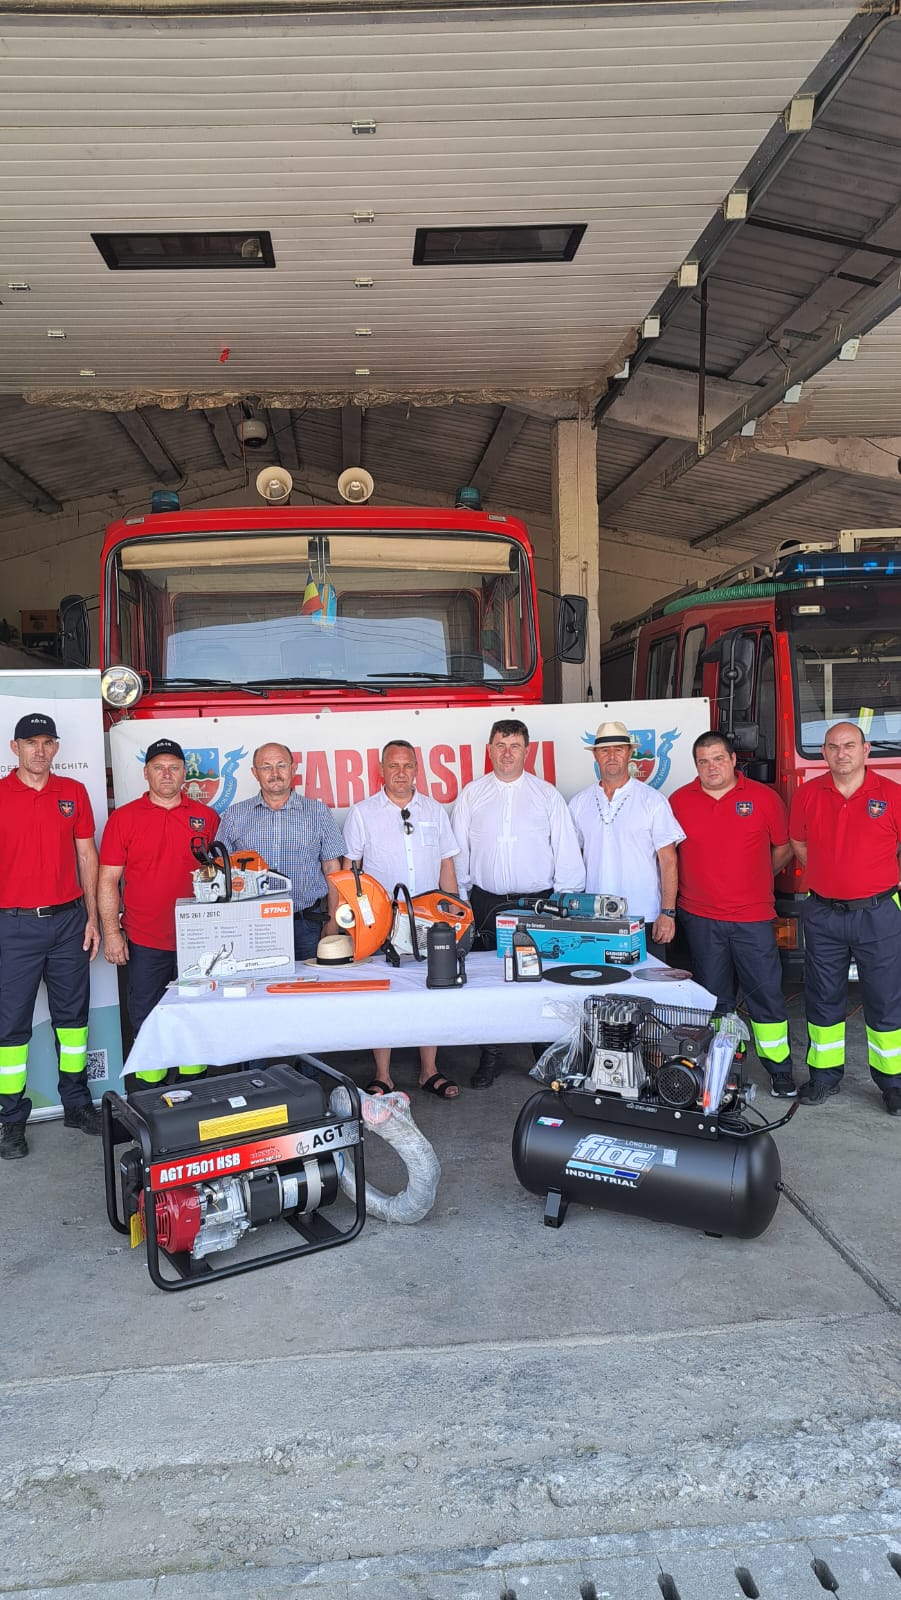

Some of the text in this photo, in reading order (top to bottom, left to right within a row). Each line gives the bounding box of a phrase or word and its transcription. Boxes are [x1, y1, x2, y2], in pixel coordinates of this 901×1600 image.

[49, 762, 89, 770] ARGHITA
[263, 906, 288, 914] STIHL
[312, 1124, 345, 1148] AGT
[625, 1139, 643, 1148] LONG
[574, 1135, 655, 1170] fiac
[159, 1153, 241, 1183] AGT 7501 HSB
[565, 1168, 638, 1188] INDUSTRIAL
